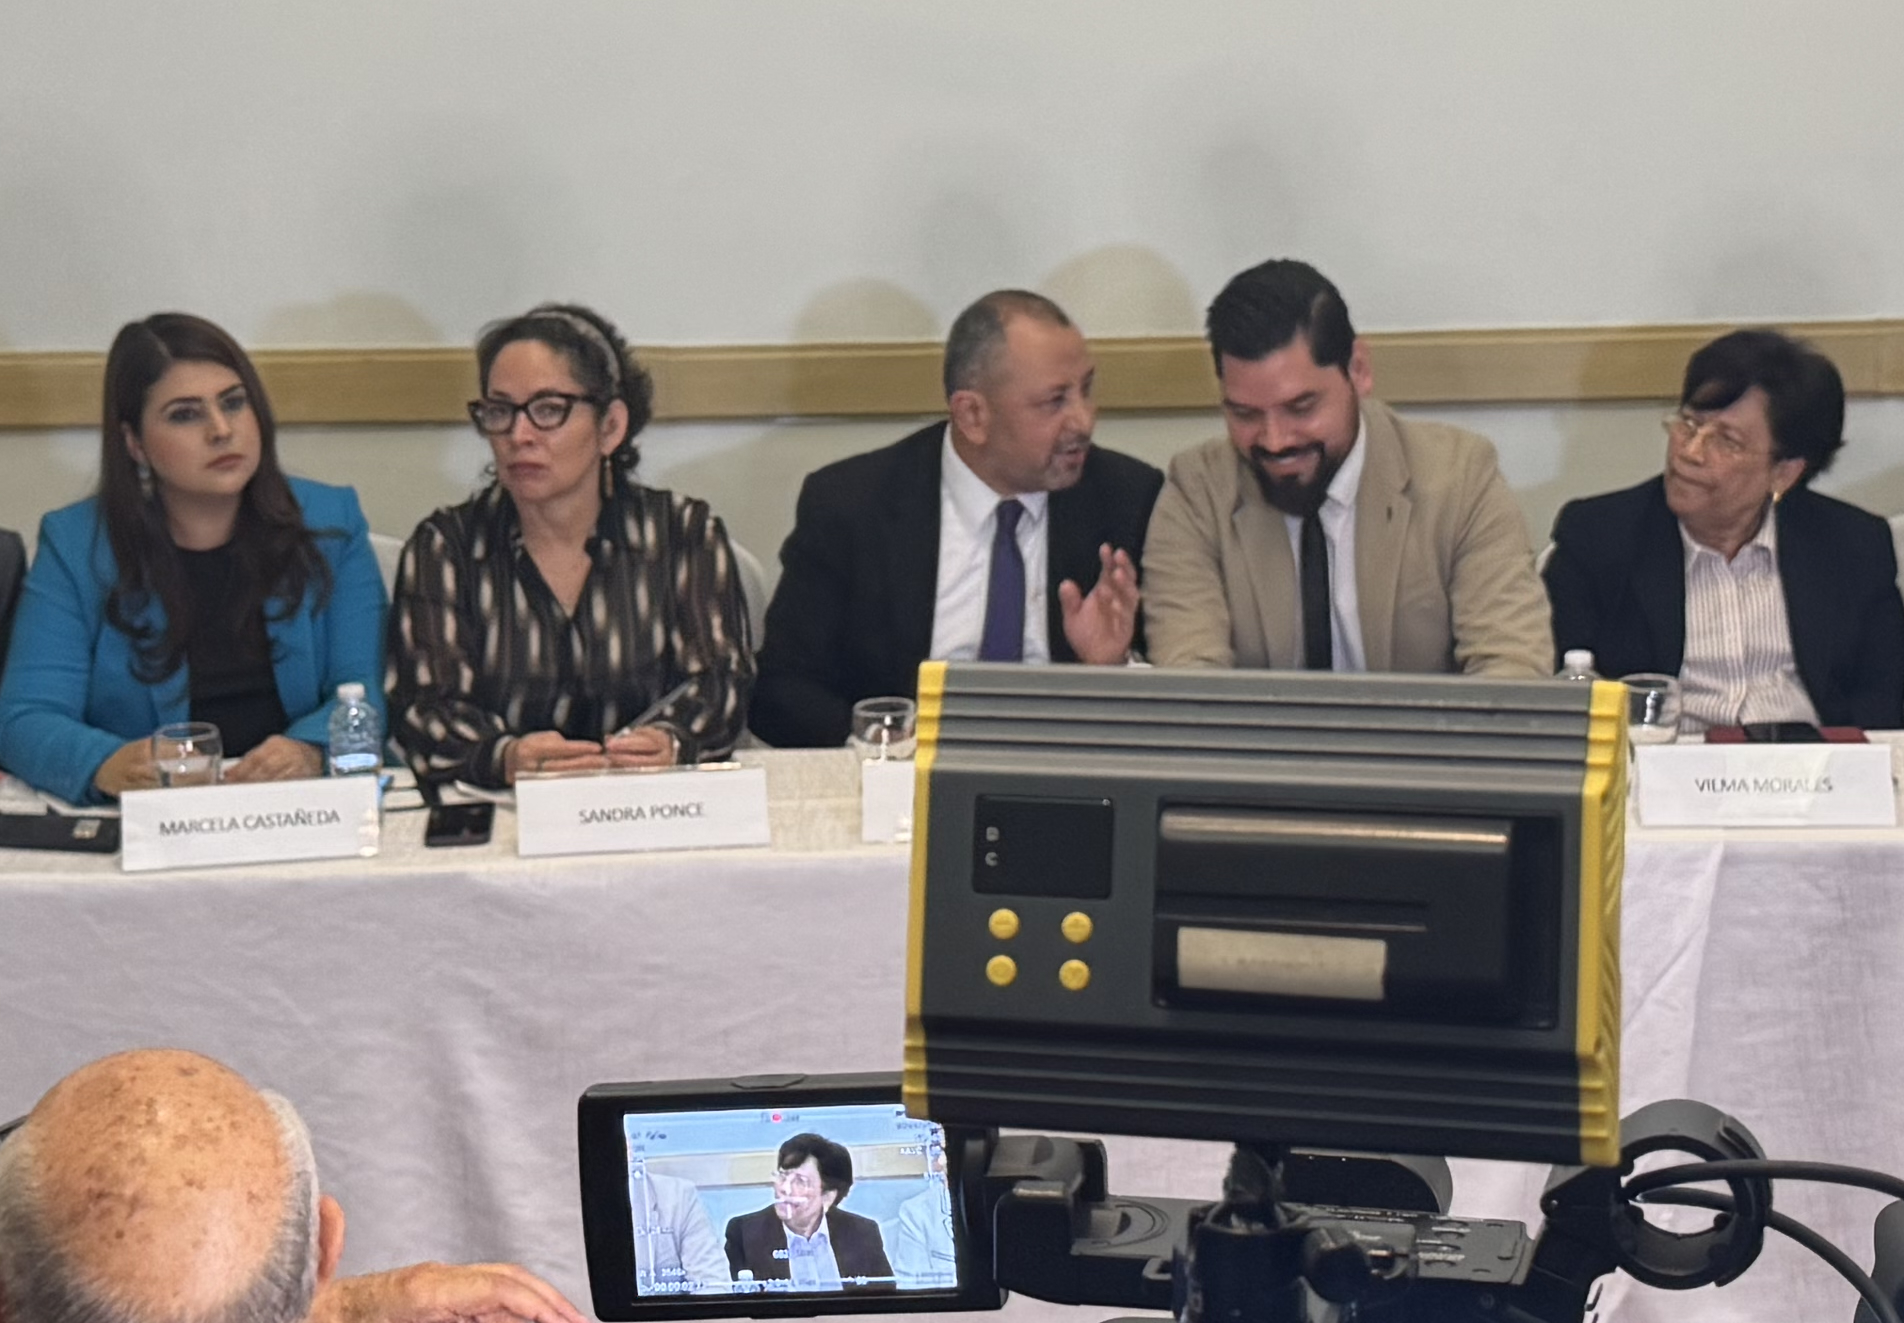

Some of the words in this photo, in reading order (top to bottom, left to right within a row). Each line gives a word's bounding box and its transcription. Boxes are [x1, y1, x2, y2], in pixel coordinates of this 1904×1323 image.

[1694, 777, 1749, 794] VILMA
[158, 816, 240, 836] MARCELA
[242, 807, 341, 831] CASTAÑEDA
[577, 805, 647, 825] SANDRA
[648, 801, 705, 819] PONCE
